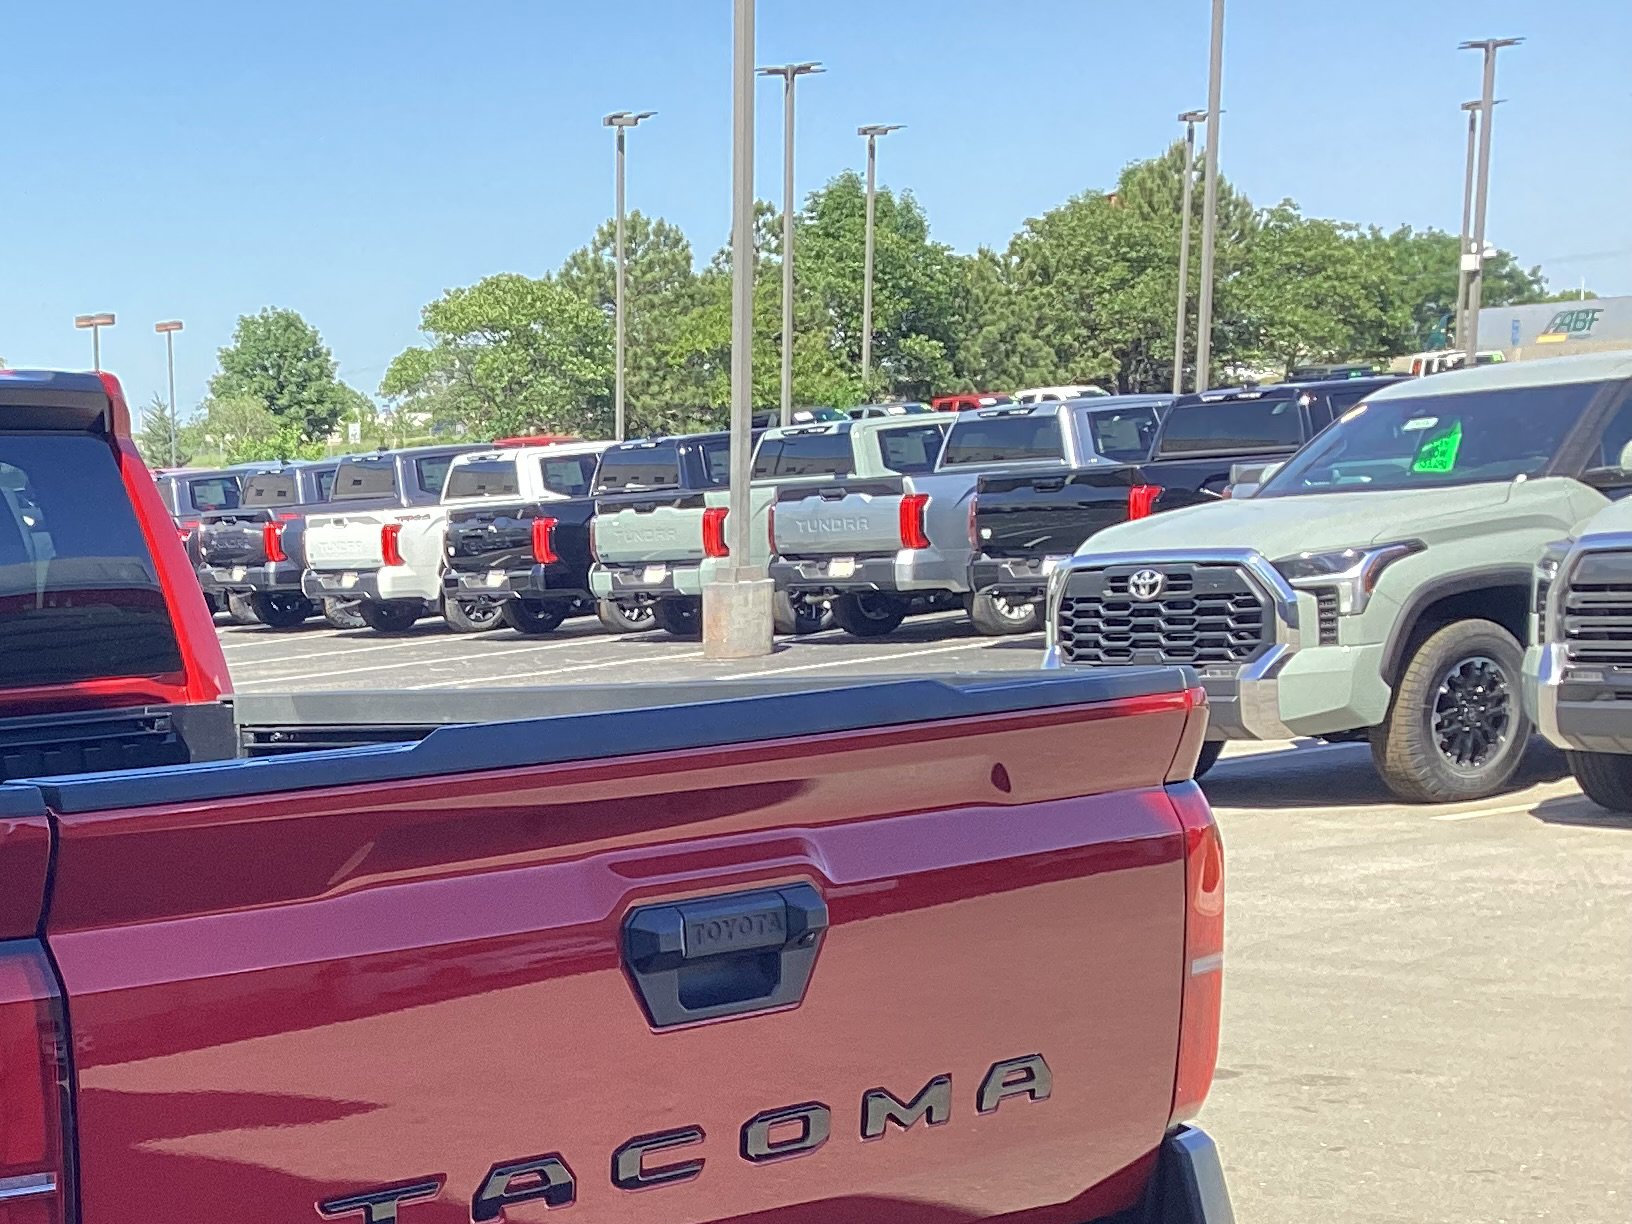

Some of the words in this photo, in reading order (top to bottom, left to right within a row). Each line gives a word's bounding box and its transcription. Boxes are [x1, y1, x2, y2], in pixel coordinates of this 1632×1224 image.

[1546, 308, 1604, 334] ABF
[613, 527, 677, 543] TUNDRA
[796, 517, 869, 533] TUNDRA
[690, 911, 784, 945] TOYOTA
